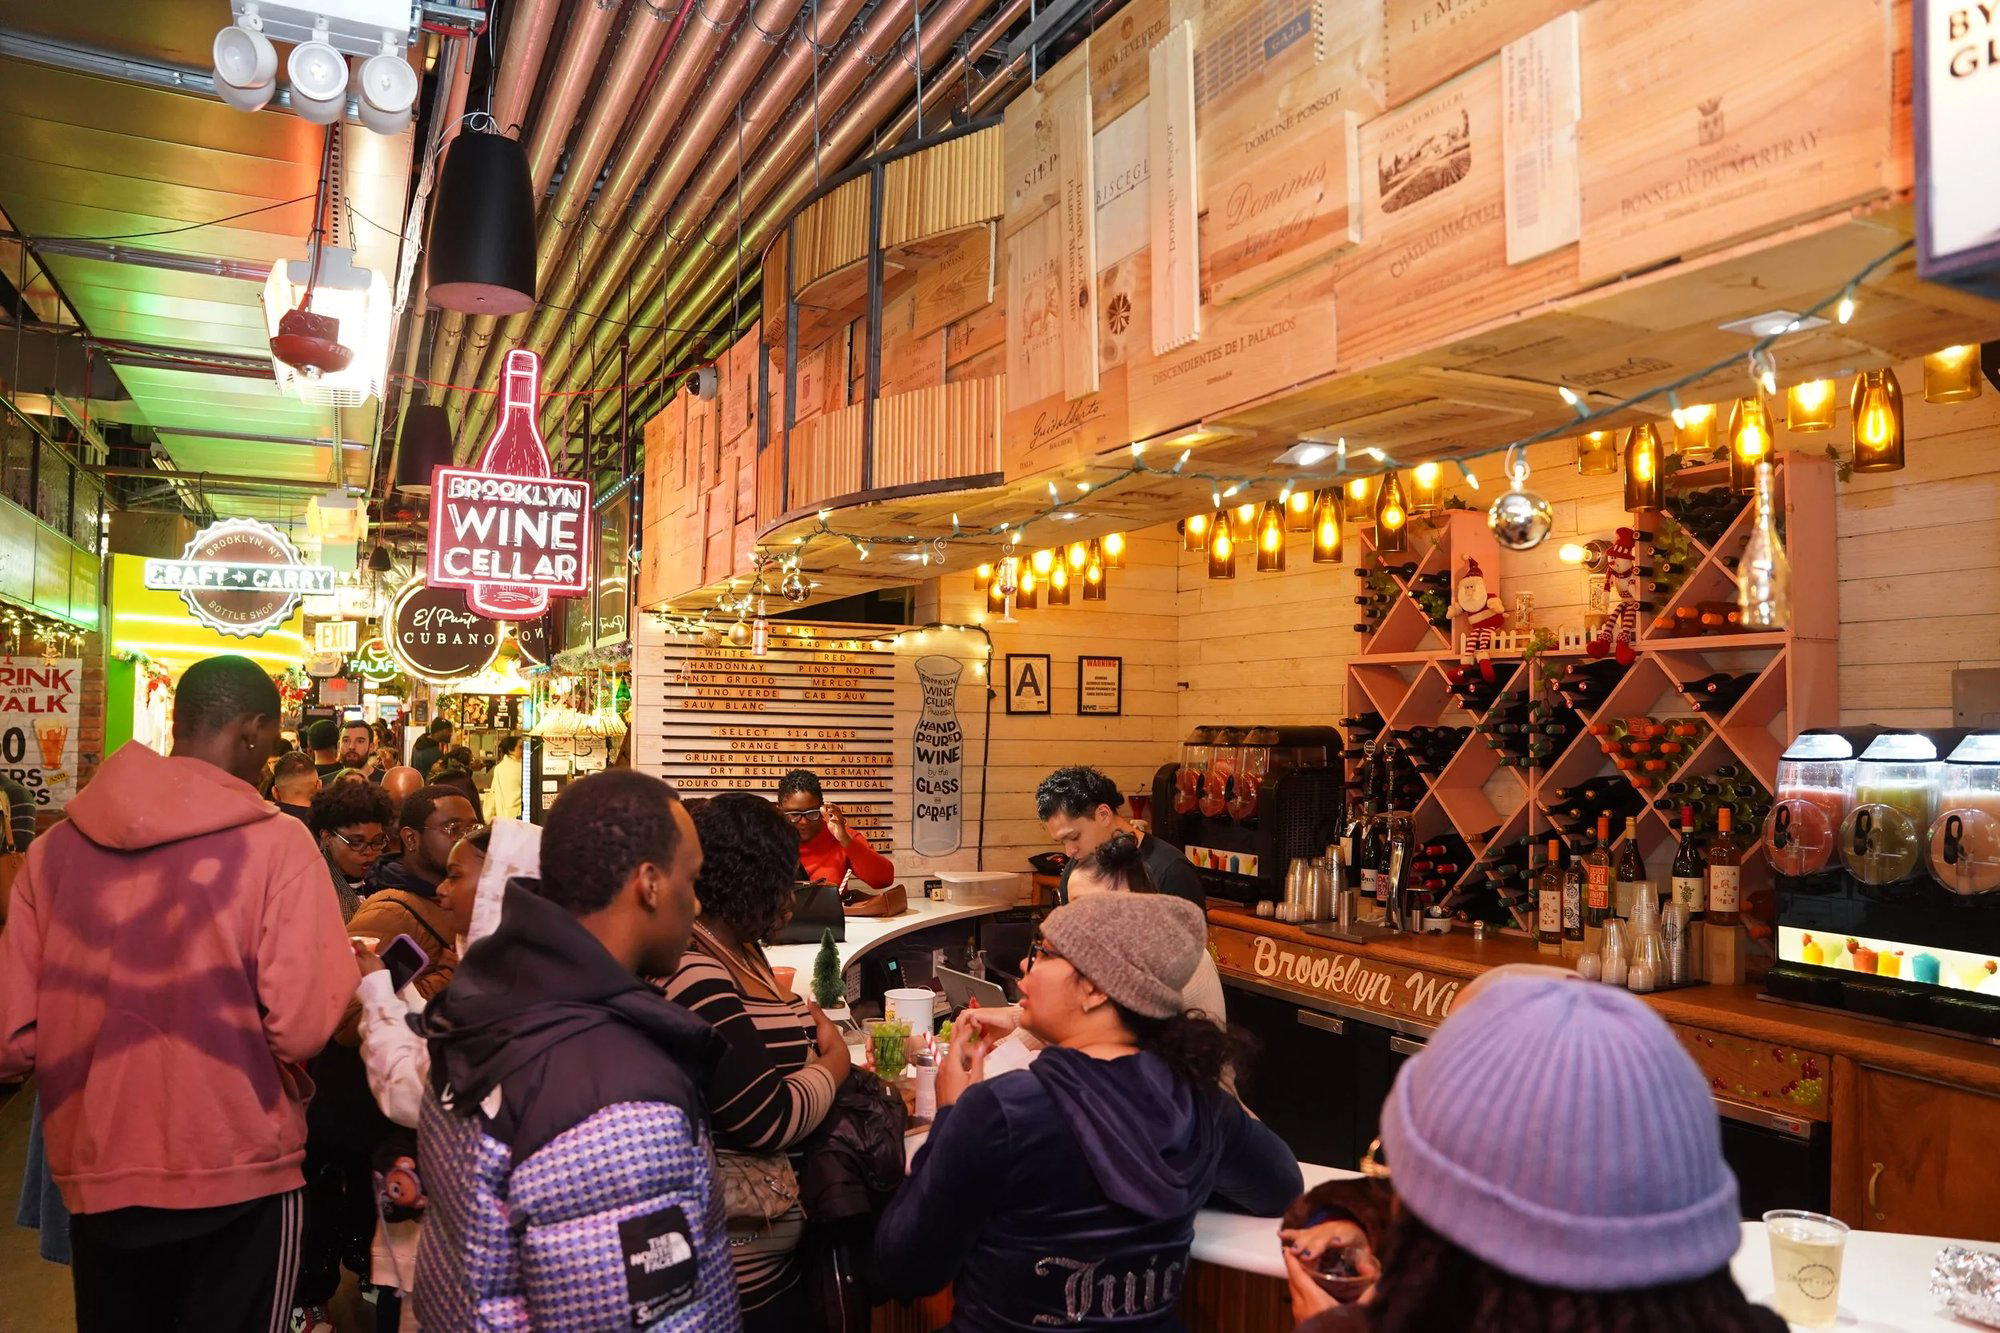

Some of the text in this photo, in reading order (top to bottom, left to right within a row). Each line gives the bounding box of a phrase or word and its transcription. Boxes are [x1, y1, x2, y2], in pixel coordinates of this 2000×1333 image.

[1949, 1, 2000, 41] BY
[1244, 88, 1342, 153] DOMAINE PONSOT
[1226, 161, 1327, 231] Dominus
[1152, 346, 1223, 386] DESCENDIENTES
[1224, 342, 1238, 356] DE
[1248, 316, 1298, 349] PALACIOS
[448, 476, 581, 510] BROOKLYN
[447, 502, 579, 551] WINE
[206, 534, 282, 560] BROOKLYN, NY
[443, 547, 578, 583] CELLAR
[150, 565, 229, 587] CRAFT
[252, 569, 330, 591] CARRY
[208, 600, 274, 621] BOTTLE SHOP
[412, 606, 437, 632] El
[321, 623, 350, 650] EXIT
[403, 631, 496, 646] CUBANO
[830, 641, 875, 651] ARFE
[824, 653, 847, 662] RED
[684, 661, 876, 675] HARDONNAY PINOT NOIR
[726, 675, 776, 685] GRIGIO
[812, 678, 860, 687] MERLOT
[1015, 663, 1042, 697] A
[697, 688, 867, 701] VINO VERDE CAB SAUV
[924, 684, 953, 697] WINE
[683, 700, 765, 711] SAUV BLANC
[925, 696, 953, 708] CELLAR
[787, 729, 809, 738] $14
[817, 730, 857, 739] GLASS
[919, 720, 956, 734] HAND
[731, 741, 779, 750] ORANGE
[805, 742, 845, 751] SPAIN
[915, 731, 962, 747] POURED
[745, 754, 816, 763] VELTLINER
[840, 756, 894, 765] AUSTRIA
[916, 746, 960, 765] WINE
[710, 767, 878, 777] DRY RESLIN GERMANY
[677, 779, 719, 788] DOURO
[728, 780, 752, 788] RED
[826, 780, 886, 789] PORTUGAL
[916, 777, 959, 796] GLASS
[857, 817, 879, 826] $12
[916, 804, 958, 822] CARAFE
[865, 830, 886, 839] $12
[1253, 935, 1460, 1018] Brooklyn Wi
[1032, 1252, 1190, 1326] Juic
